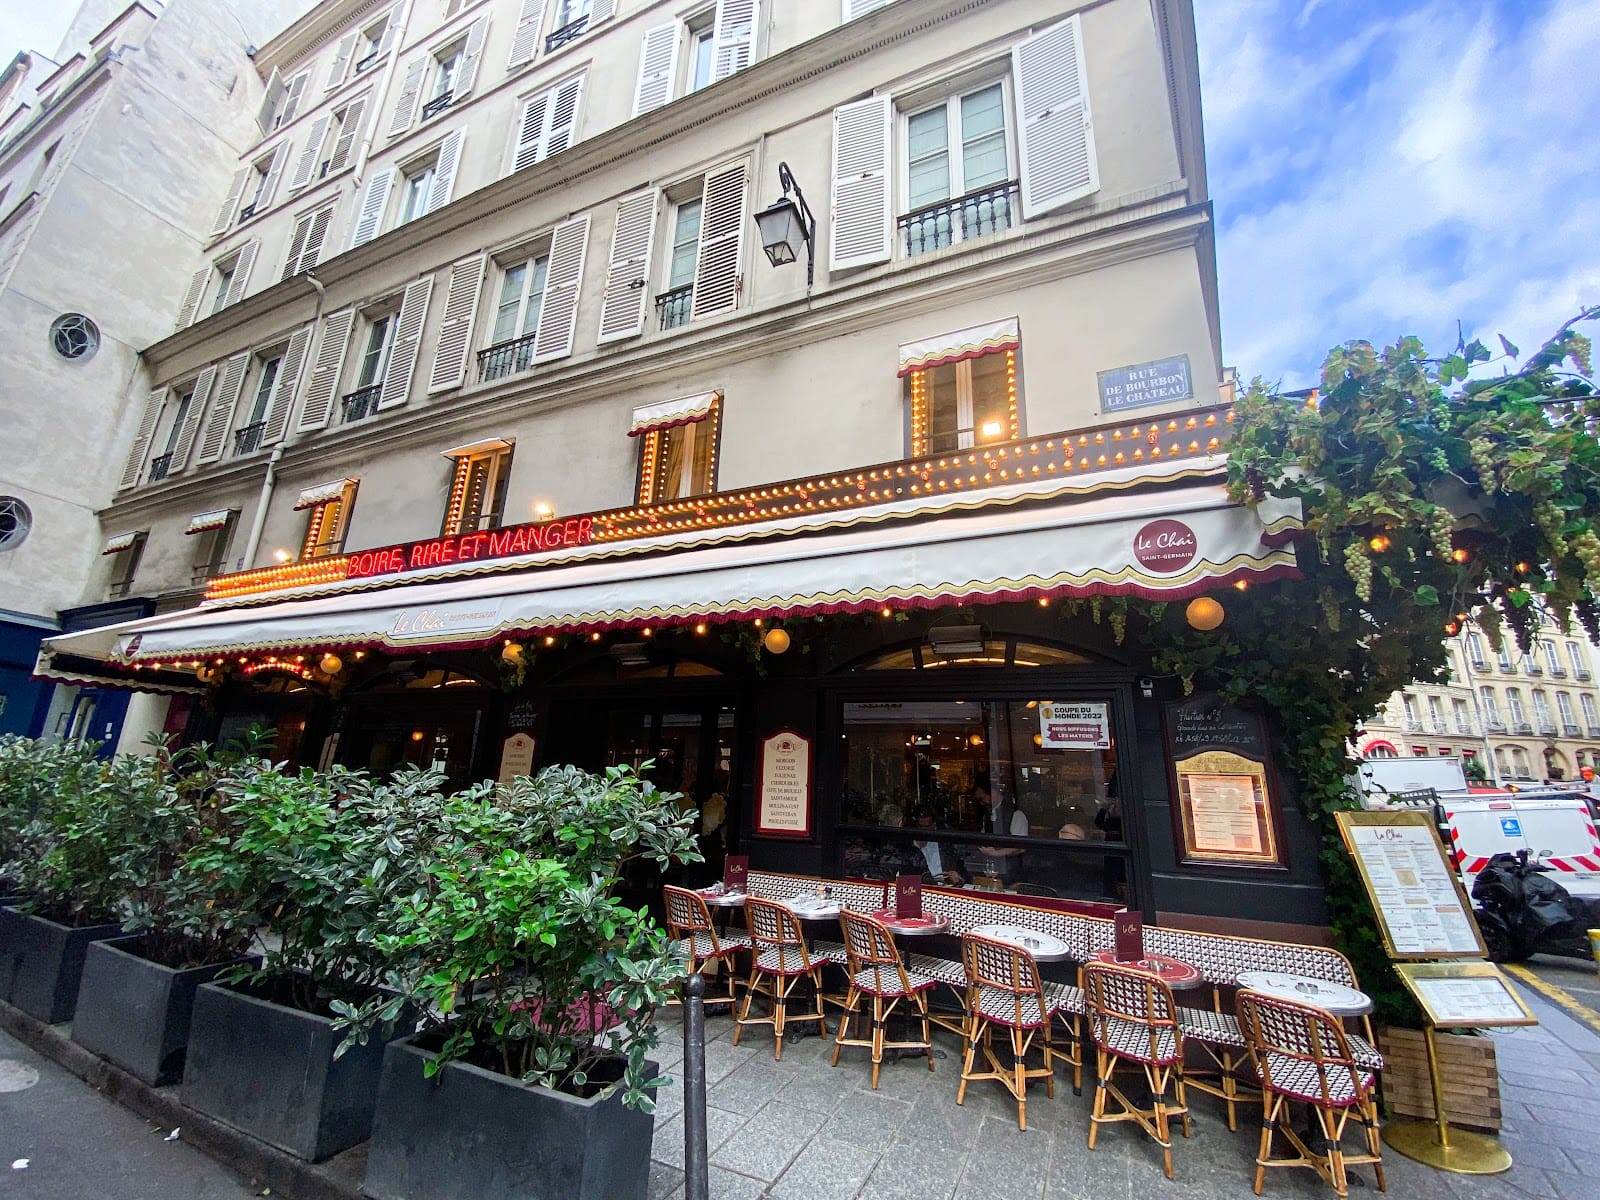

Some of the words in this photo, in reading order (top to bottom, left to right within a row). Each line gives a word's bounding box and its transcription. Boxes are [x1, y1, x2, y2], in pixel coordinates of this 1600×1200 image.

[1106, 386, 1122, 396] DE
[1126, 373, 1184, 392] BOURBON
[1129, 368, 1158, 381] RUE
[1107, 396, 1124, 406] LE
[1126, 384, 1185, 403] CHÂTEAU
[348, 548, 403, 576] BOIRE,
[410, 540, 455, 568] RIRE
[458, 534, 487, 560] ET
[489, 518, 593, 555] MANGER
[1138, 535, 1151, 550] Le
[1156, 531, 1194, 548] Chai
[1141, 552, 1193, 561] SAINT-GERMAIN
[393, 609, 408, 633] Le
[412, 609, 449, 632] Chai
